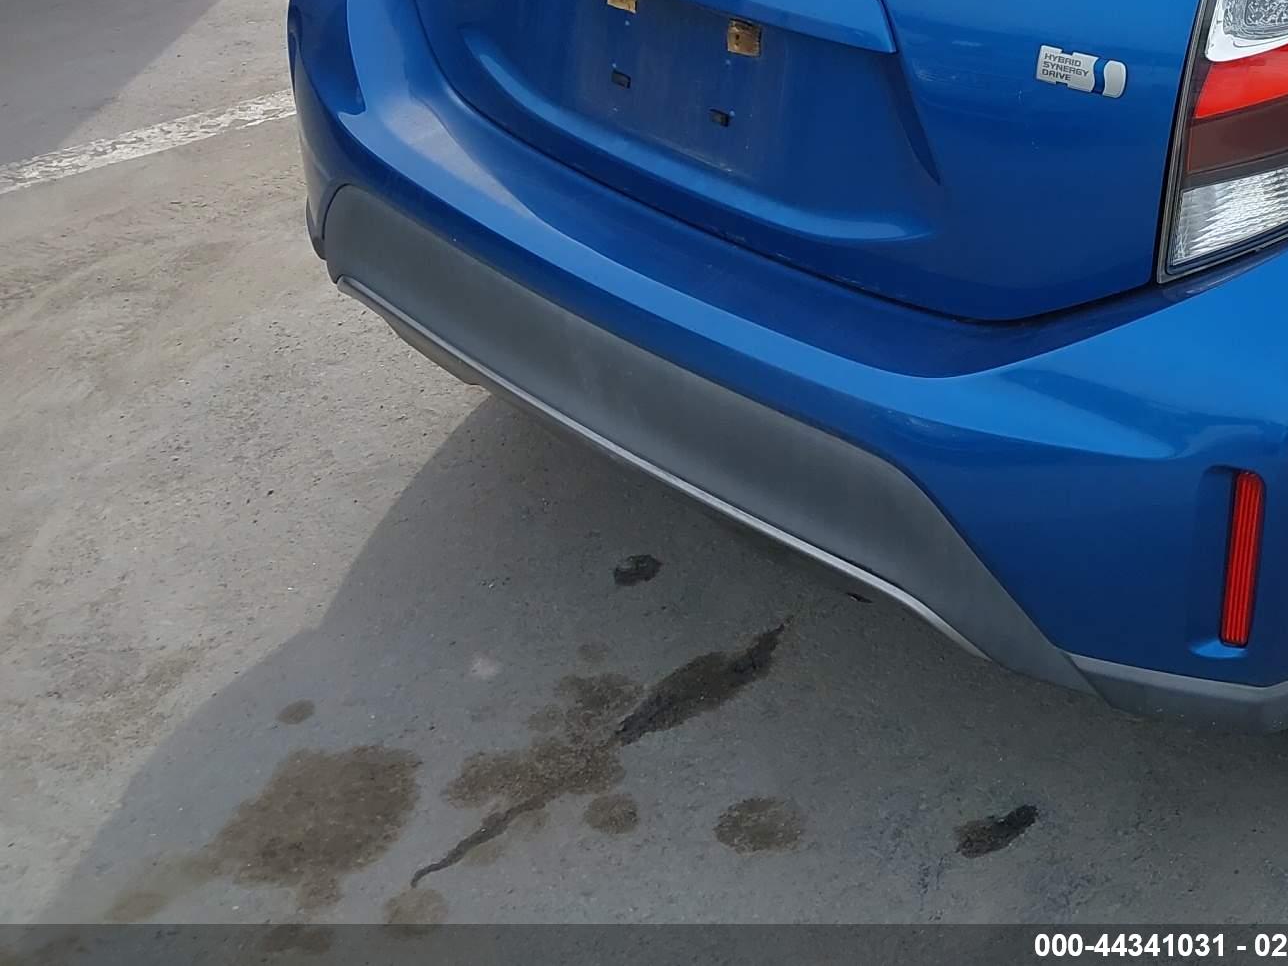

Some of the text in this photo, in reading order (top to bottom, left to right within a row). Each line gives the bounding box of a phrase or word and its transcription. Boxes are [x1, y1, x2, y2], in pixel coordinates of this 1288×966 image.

[1044, 52, 1082, 68] HYBRID
[1041, 68, 1072, 82] DRIVE
[1042, 60, 1090, 78] SYNERGY
